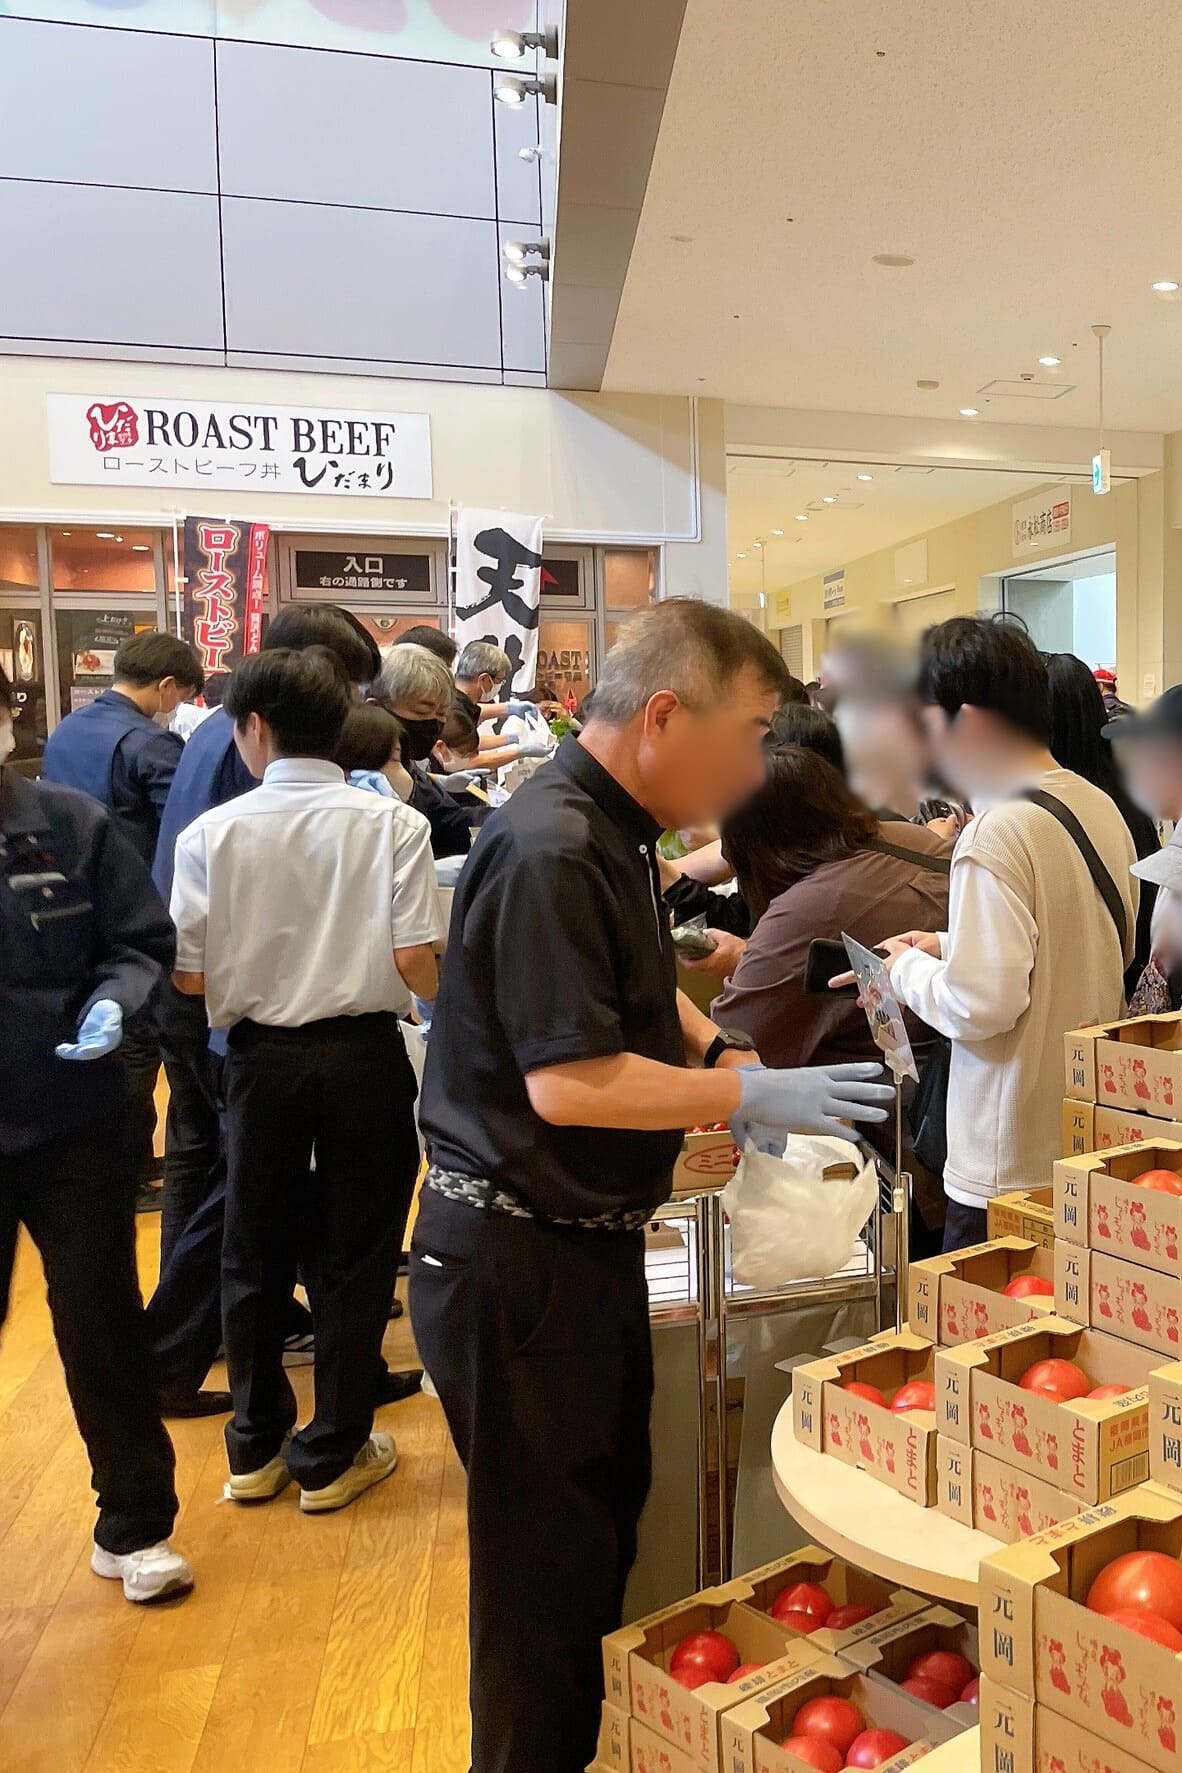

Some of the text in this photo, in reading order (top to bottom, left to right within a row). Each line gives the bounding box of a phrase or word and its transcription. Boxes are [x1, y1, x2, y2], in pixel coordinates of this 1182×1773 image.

[143, 408, 396, 457] ROAST BEEF
[103, 456, 281, 480] ローストビーフ丼
[292, 457, 394, 491] ひだまり
[319, 576, 408, 590] 右の通路側です
[343, 556, 384, 575] 入口
[195, 527, 238, 674] ローストビー
[537, 650, 581, 670] OAST
[1072, 1043, 1085, 1088] 元岡
[1072, 1110, 1085, 1154] 元岡
[1064, 1175, 1077, 1227] 元岡
[916, 1276, 929, 1324] 元岡
[1065, 1254, 1079, 1306] 元岡
[801, 1383, 813, 1433] 元岡
[945, 1371, 959, 1425] 元岡
[1072, 1418, 1085, 1489] とまと
[1162, 1392, 1181, 1468] 元岡
[906, 1427, 917, 1490] とまと
[948, 1452, 962, 1507] 元岡
[992, 1585, 1014, 1667] 元岡
